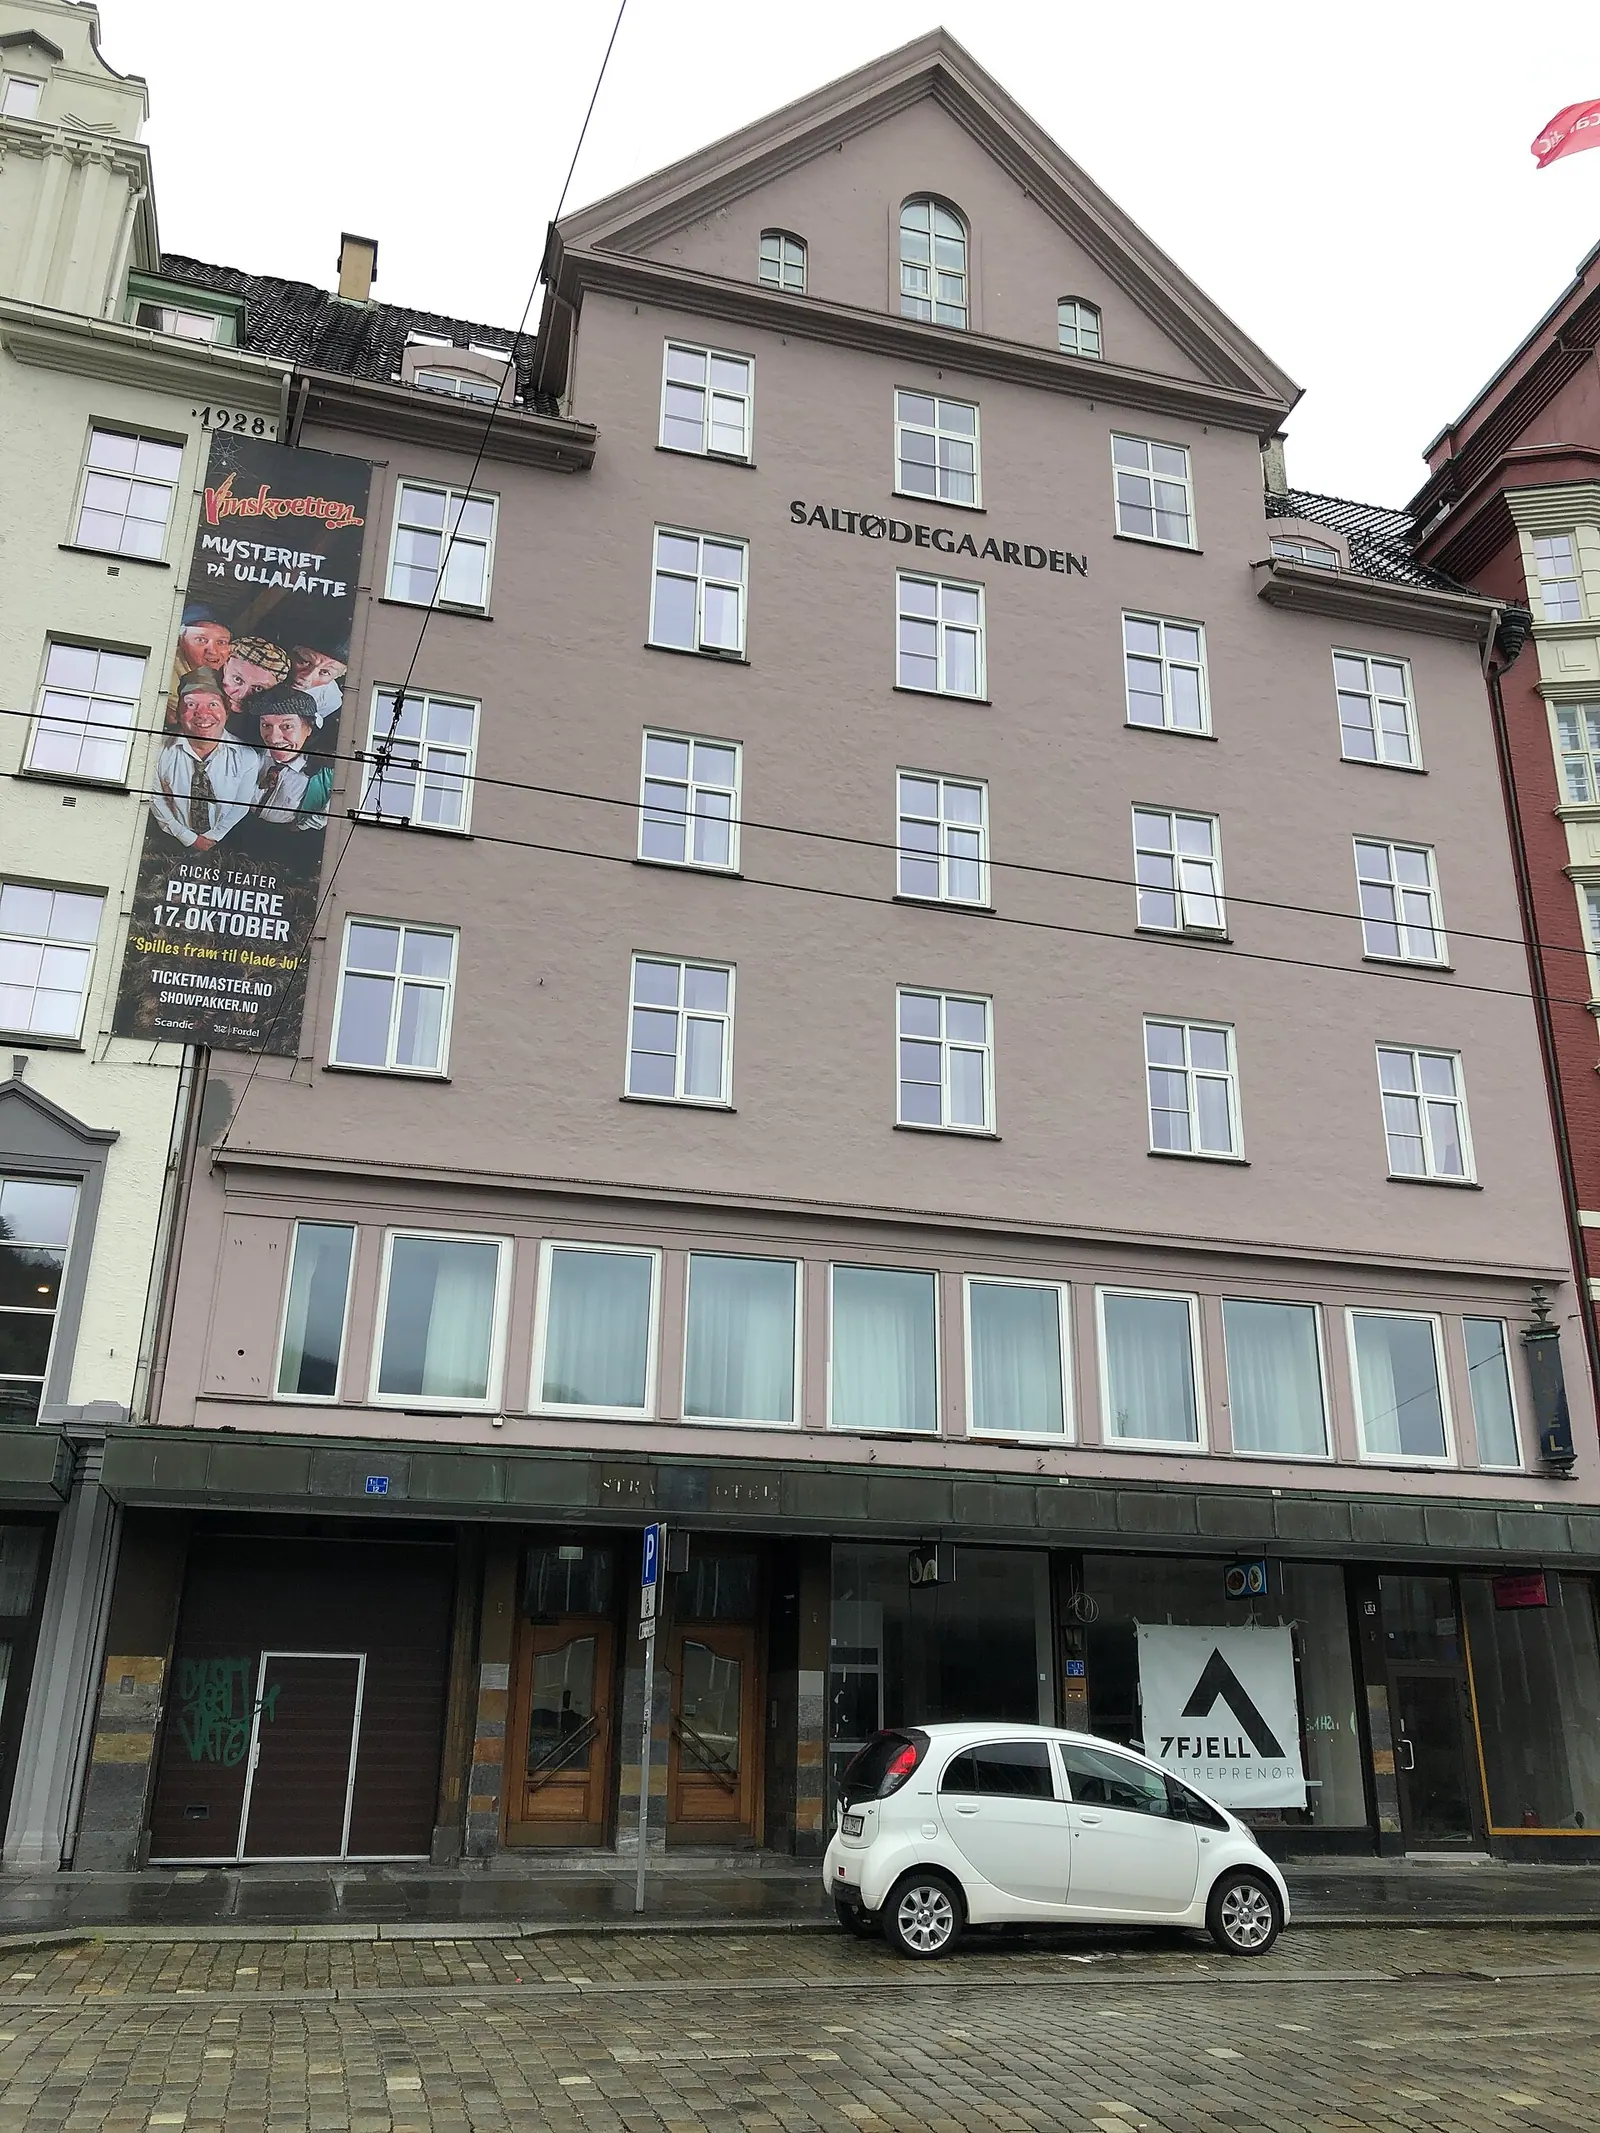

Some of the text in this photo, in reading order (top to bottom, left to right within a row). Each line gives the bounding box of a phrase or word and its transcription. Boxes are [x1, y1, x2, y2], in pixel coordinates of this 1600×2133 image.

[205, 472, 364, 529] Vinskvetten
[790, 500, 1089, 578] SALTØDEGAARDEN
[201, 534, 327, 573] MYSTERIET
[207, 562, 348, 598] PÅ ULLALÅFTE
[179, 864, 277, 889] RICKS TEATER
[165, 880, 284, 917] PREMIERE
[183, 942, 218, 960] fram
[221, 949, 237, 963] til
[240, 950, 276, 968] Glade
[151, 969, 273, 997] TICKETMASTER.NO
[159, 990, 259, 1014] SHOWPAKKER.NO
[154, 1017, 194, 1030] Scandic
[232, 1027, 260, 1037] Fordel
[646, 1533, 655, 1578] P
[1160, 1736, 1251, 1758] 7FJELL
[1167, 1767, 1296, 1780] NTREPRENØR
